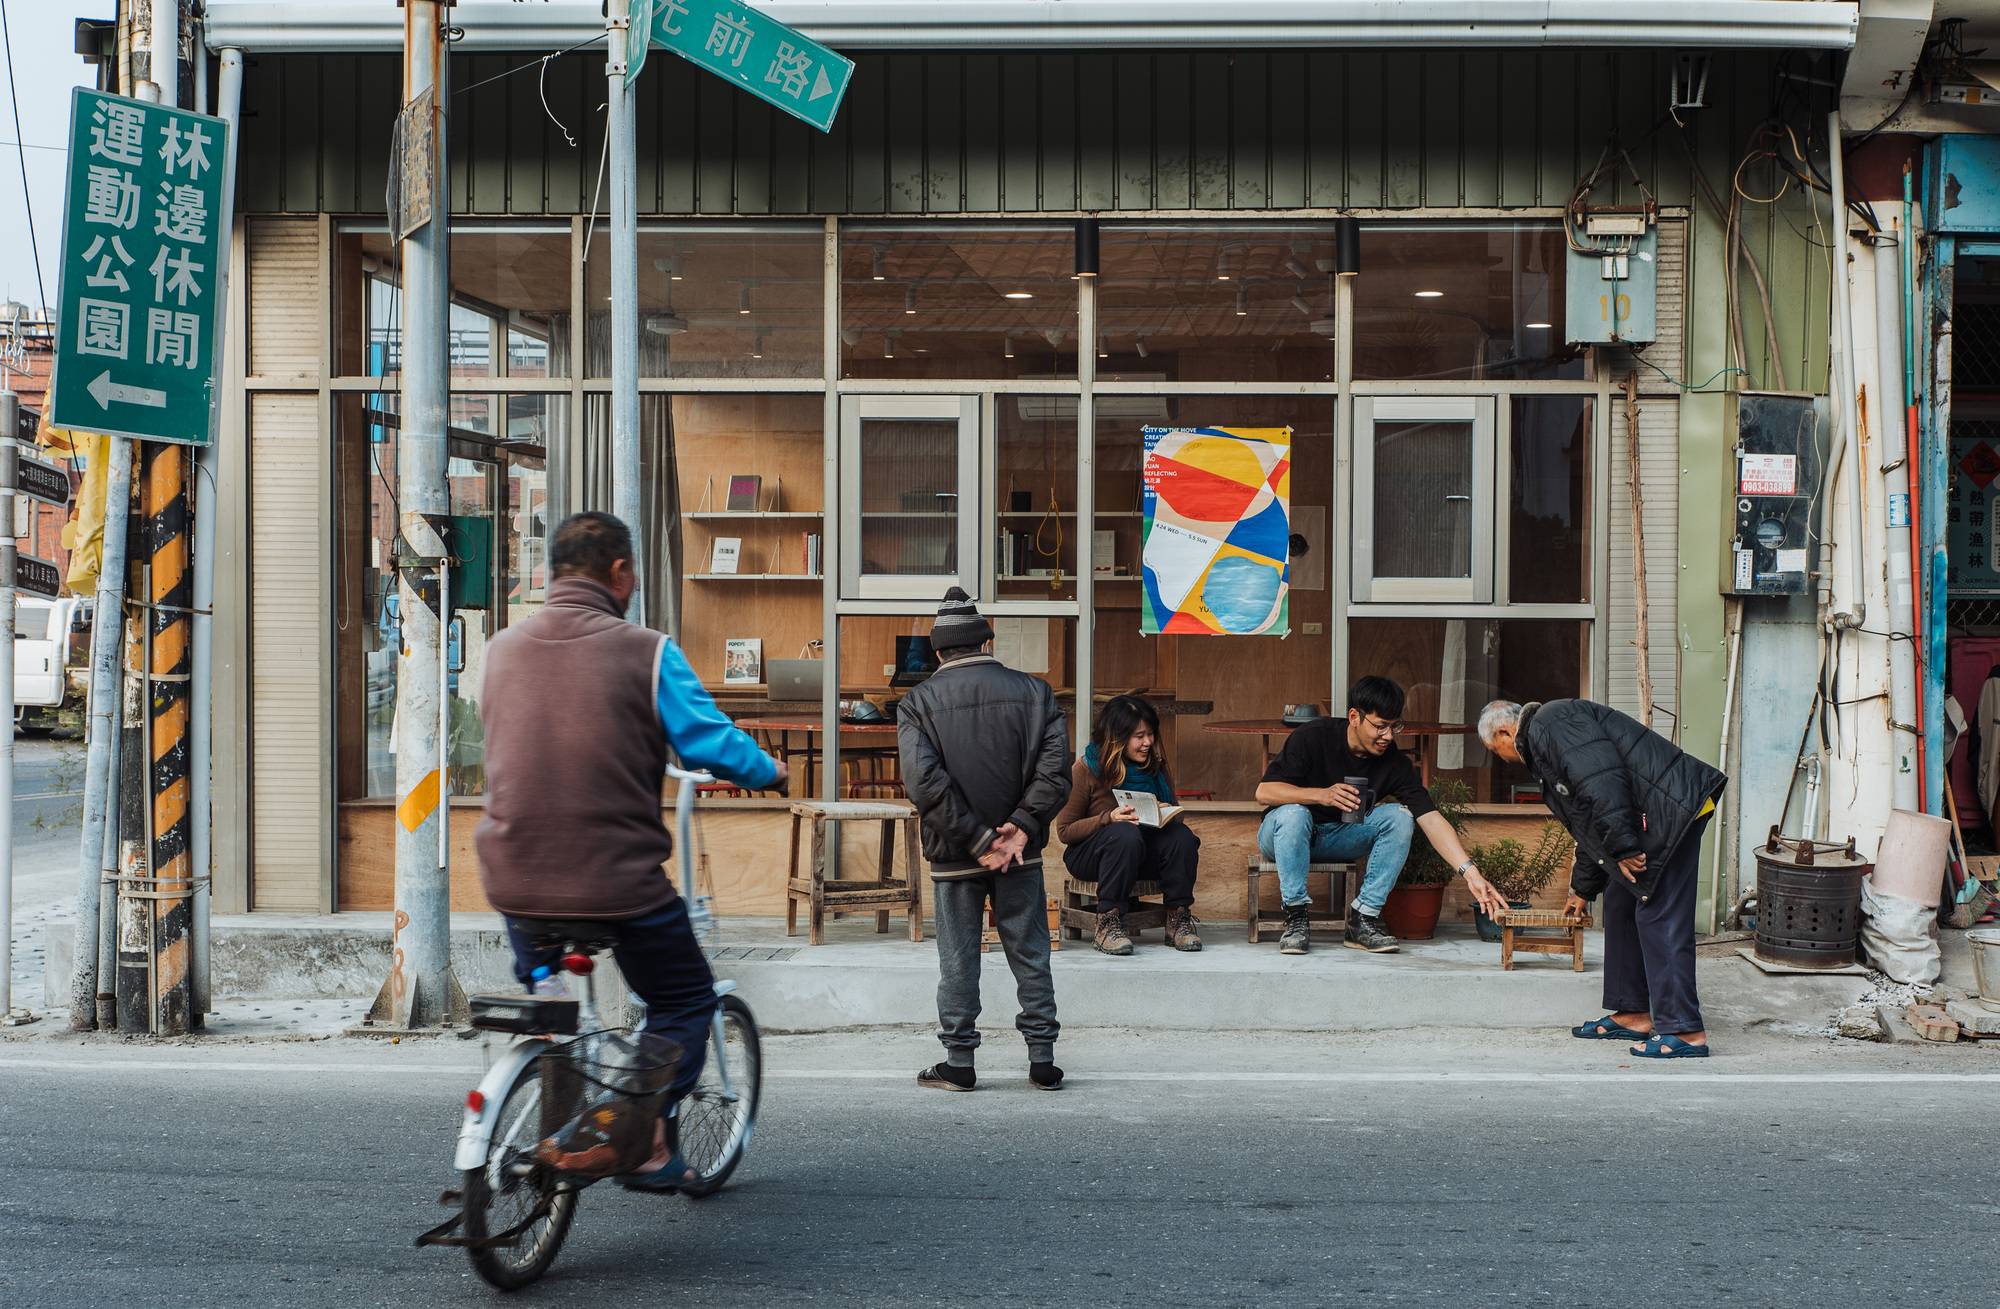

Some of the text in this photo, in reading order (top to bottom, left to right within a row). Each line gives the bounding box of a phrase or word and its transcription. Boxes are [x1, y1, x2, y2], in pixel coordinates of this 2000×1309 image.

[77, 98, 146, 361] 運動公園
[145, 117, 212, 370] 林邊休閒
[1600, 294, 1630, 321] 10
[1183, 441, 1203, 454] DESIGN
[1743, 481, 1792, 493] 0903-038899
[1167, 526, 1180, 535] WED
[1196, 536, 1208, 544] SUN
[1968, 490, 1984, 568] 熱帶漁林
